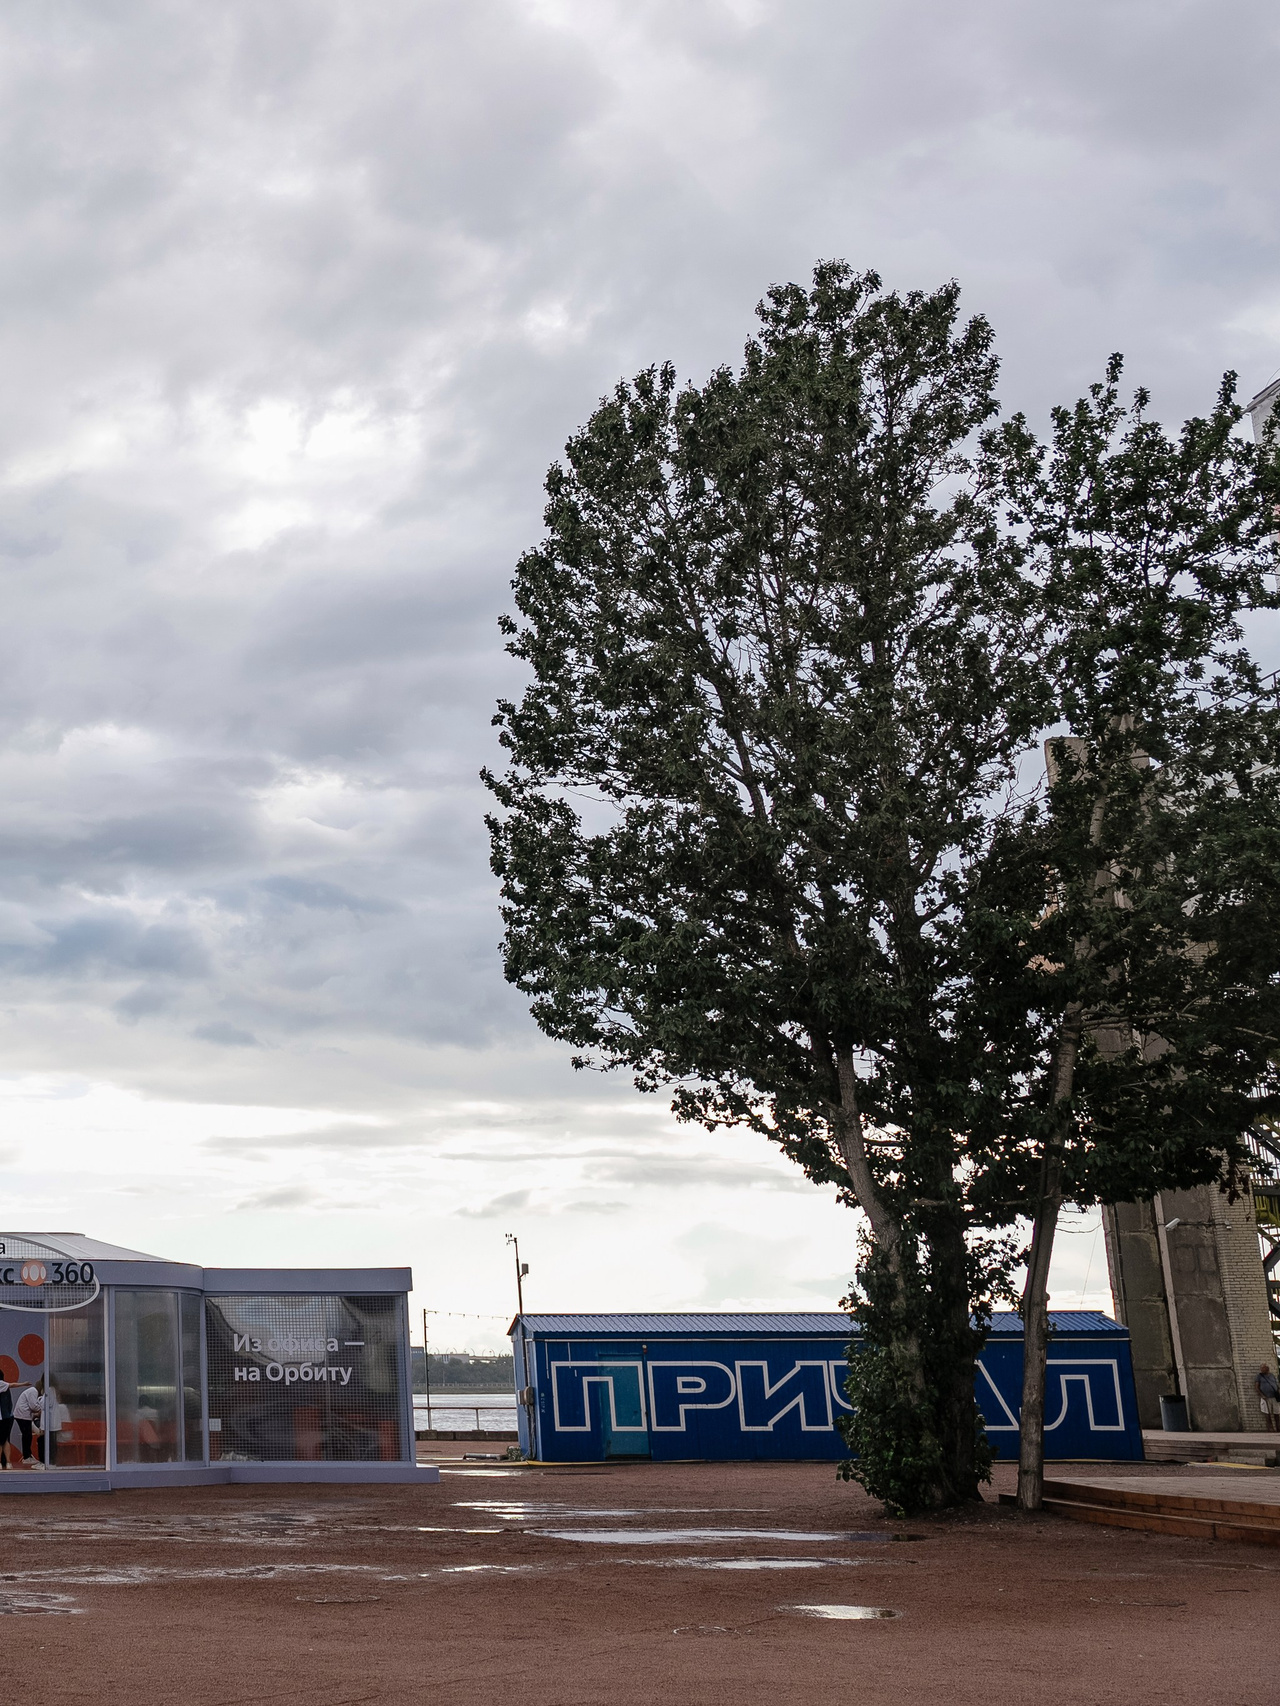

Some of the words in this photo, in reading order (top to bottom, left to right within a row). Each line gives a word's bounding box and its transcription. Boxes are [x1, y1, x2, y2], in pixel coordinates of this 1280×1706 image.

[51, 1262, 94, 1284] 360
[233, 1333, 262, 1352] Из
[267, 1332, 339, 1355] офиса
[234, 1366, 261, 1382] на
[265, 1362, 352, 1385] Орбиту
